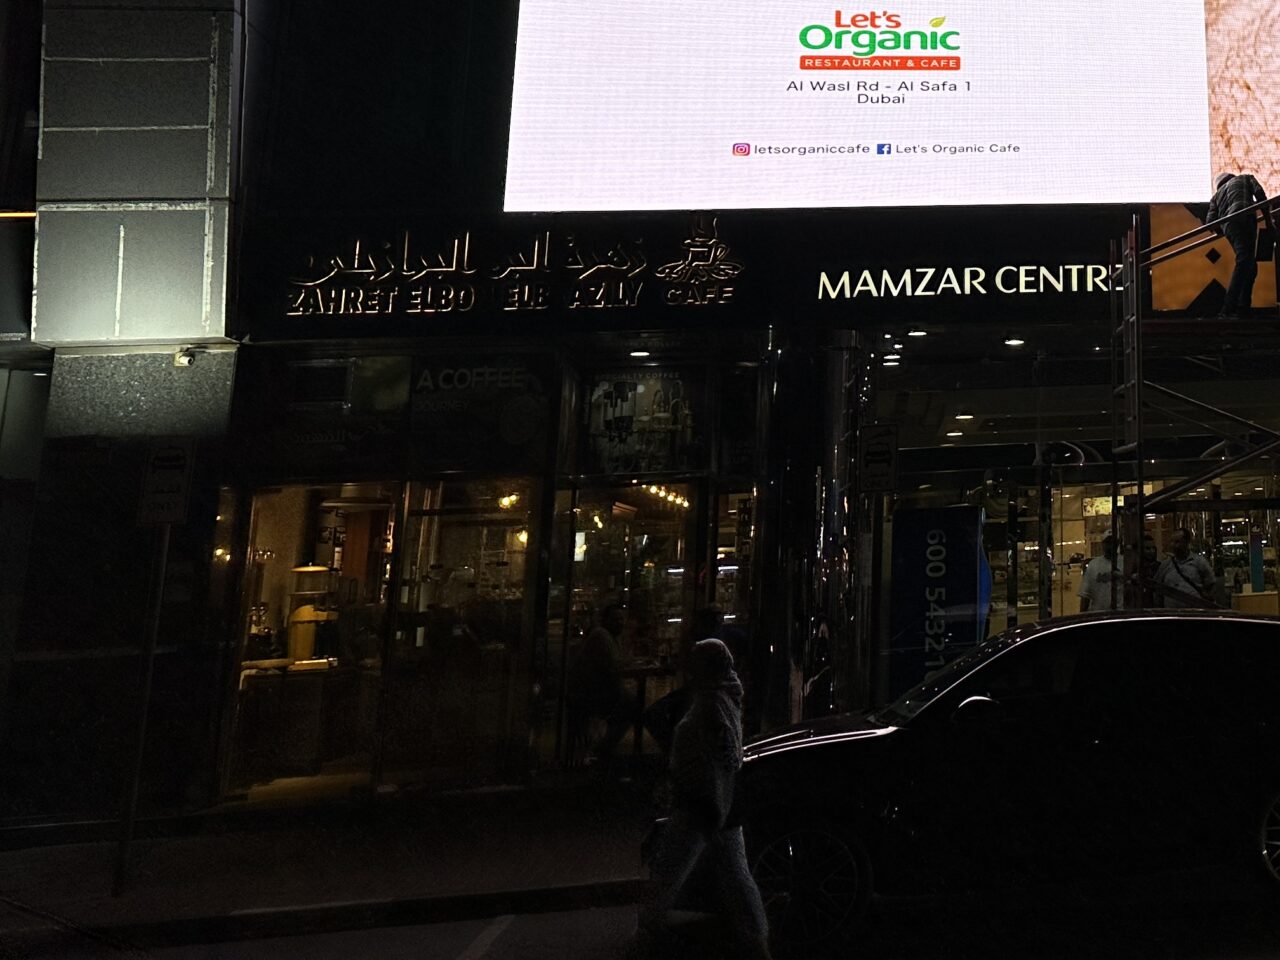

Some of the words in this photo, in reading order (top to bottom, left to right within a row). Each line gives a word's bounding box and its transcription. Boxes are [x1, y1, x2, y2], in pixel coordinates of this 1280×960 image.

[835, 10, 900, 29] Let's
[799, 23, 961, 57] Organic
[804, 58, 901, 68] RESTAURANT
[906, 58, 915, 68] &
[920, 58, 957, 68] CAFE
[786, 80, 804, 92] Al
[810, 80, 850, 92] Wasl
[857, 80, 879, 92] Rd
[897, 80, 914, 92] Al
[920, 80, 958, 92] Safa
[857, 93, 906, 105] Dubai
[754, 143, 870, 156] letsorganiccafe
[896, 143, 928, 154] Let's
[932, 143, 985, 156] Organic
[989, 143, 1021, 154] Cafe
[818, 267, 987, 300] MAMZAR
[286, 286, 399, 316] ZAHRET
[663, 285, 735, 307] CAFE
[438, 366, 527, 390] COFFEE
[924, 528, 947, 580] 600
